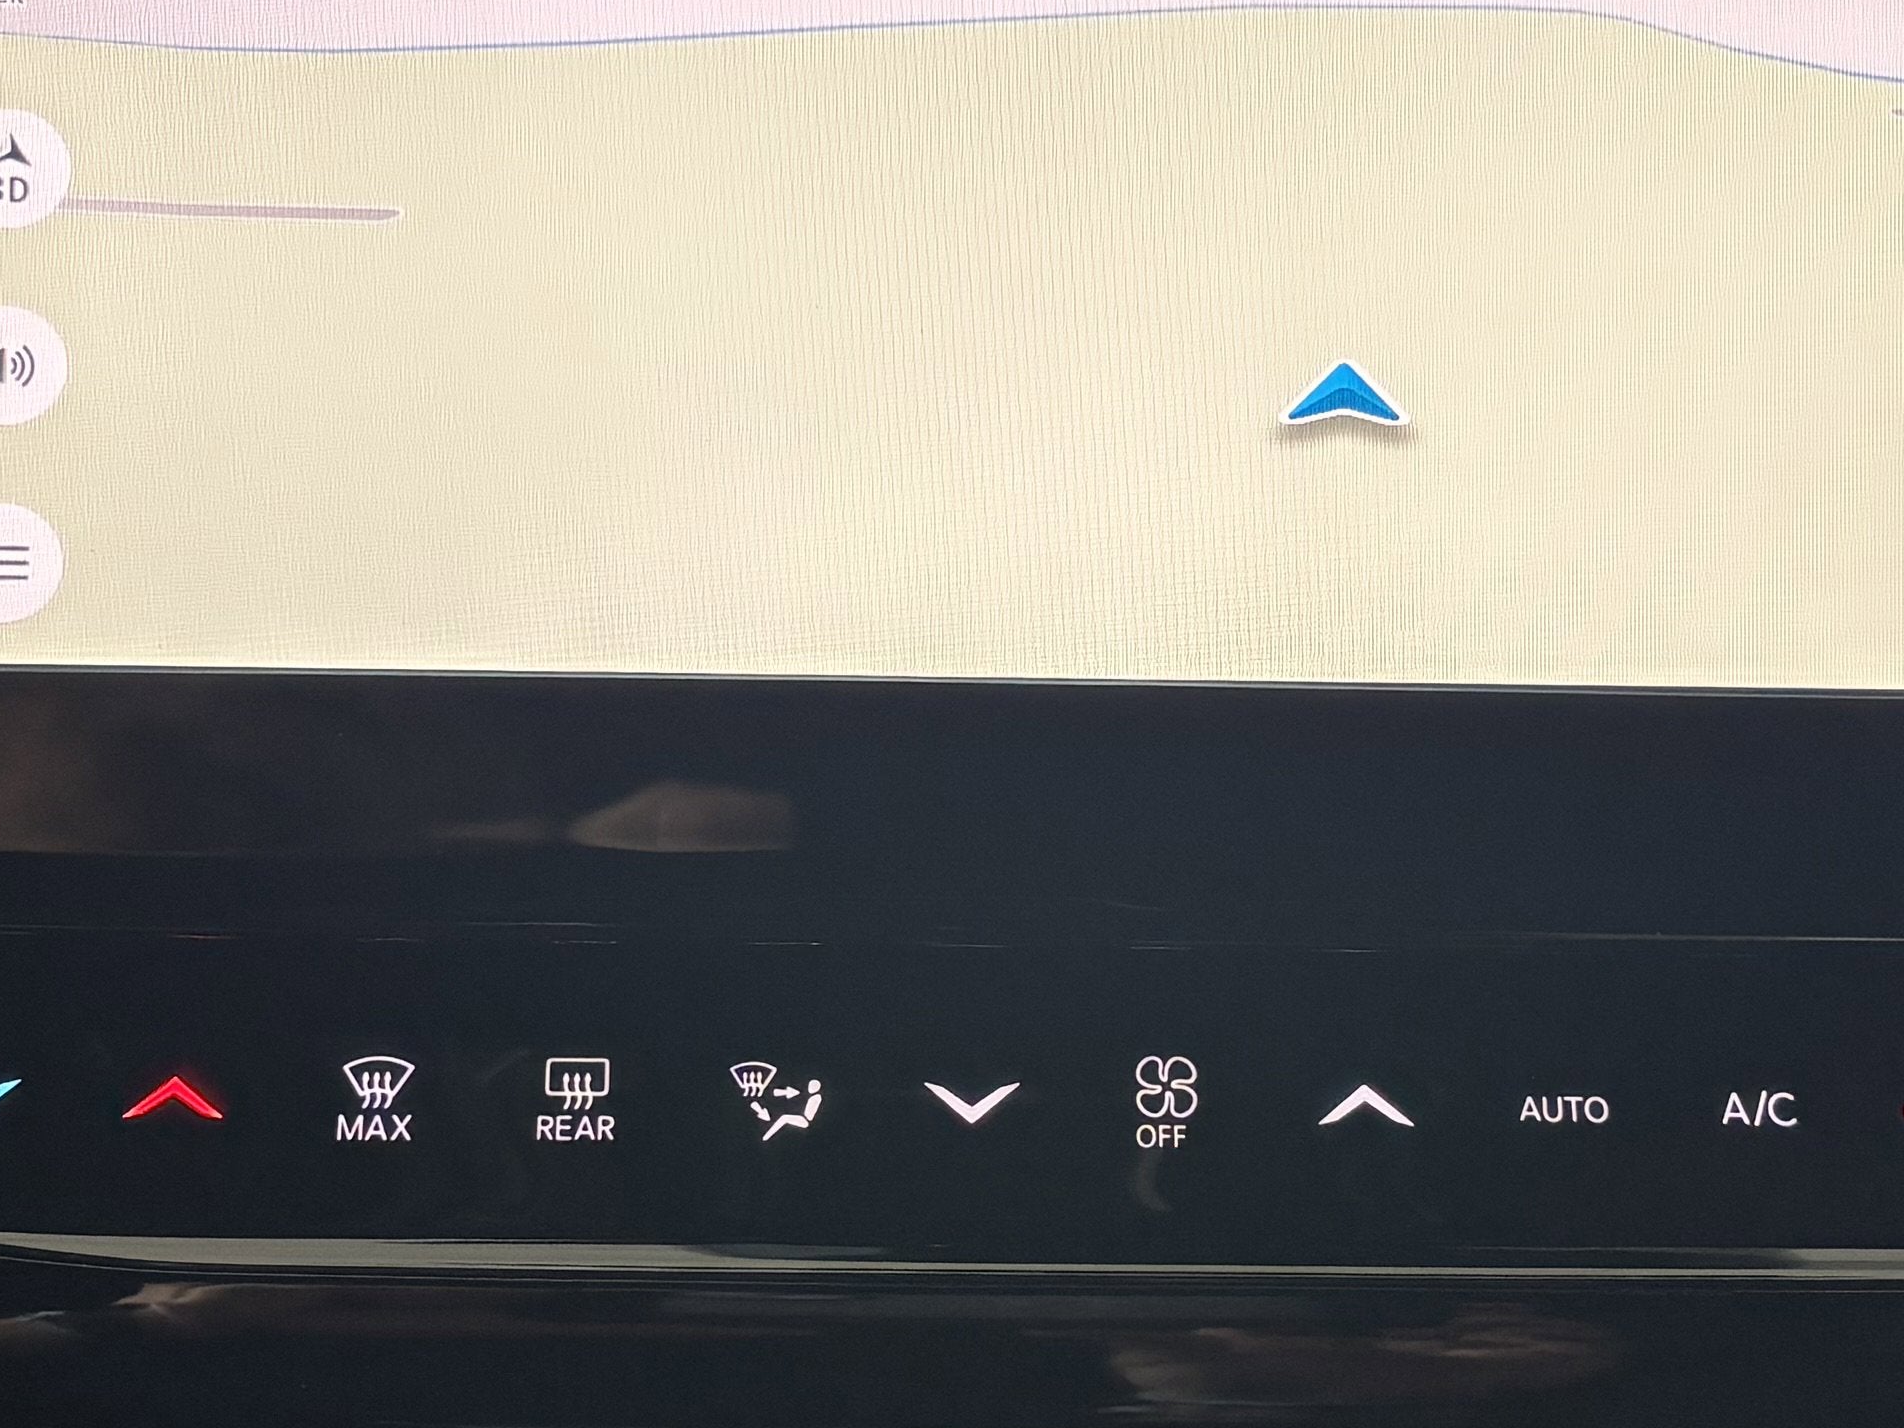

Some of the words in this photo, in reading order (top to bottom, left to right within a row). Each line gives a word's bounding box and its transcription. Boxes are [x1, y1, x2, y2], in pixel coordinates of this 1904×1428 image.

[1518, 1095, 1610, 1123] AUTO
[1721, 1089, 1798, 1127] A/C
[335, 1113, 413, 1141] MAX
[535, 1113, 616, 1142] REAR
[1134, 1123, 1188, 1149] OFF
